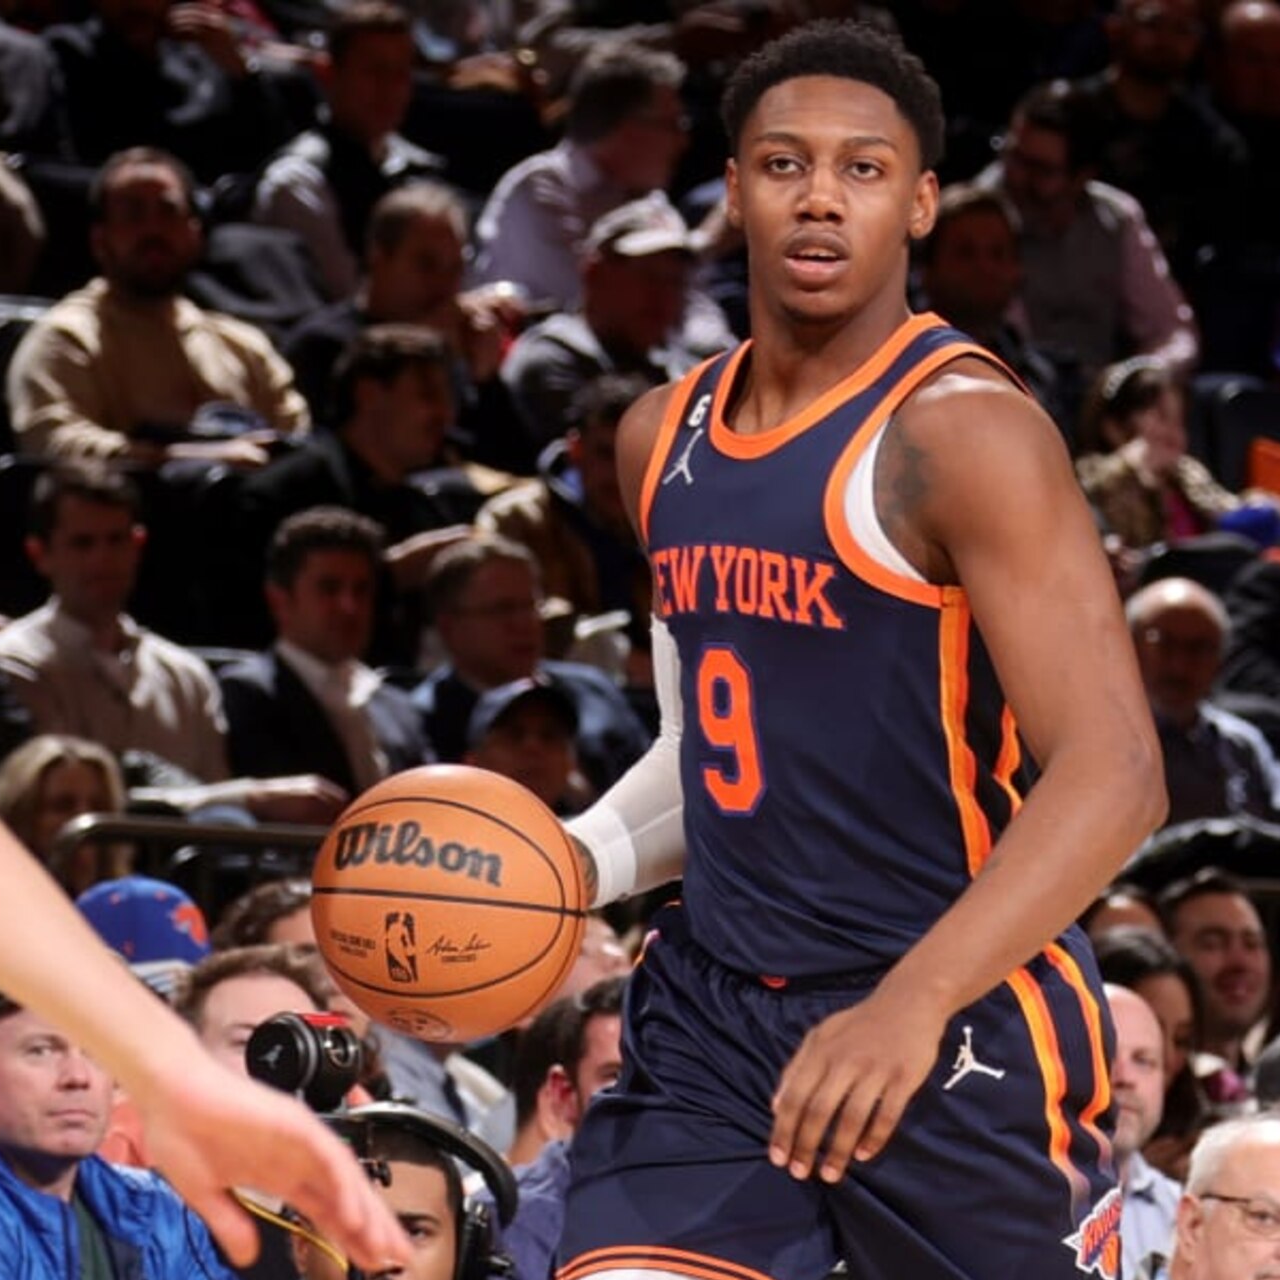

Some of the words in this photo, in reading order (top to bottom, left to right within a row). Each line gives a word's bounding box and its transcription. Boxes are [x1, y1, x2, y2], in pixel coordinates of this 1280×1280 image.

[651, 544, 706, 618] EW
[710, 544, 847, 631] YORK
[696, 644, 765, 816] 9
[333, 820, 503, 888] Wilson
